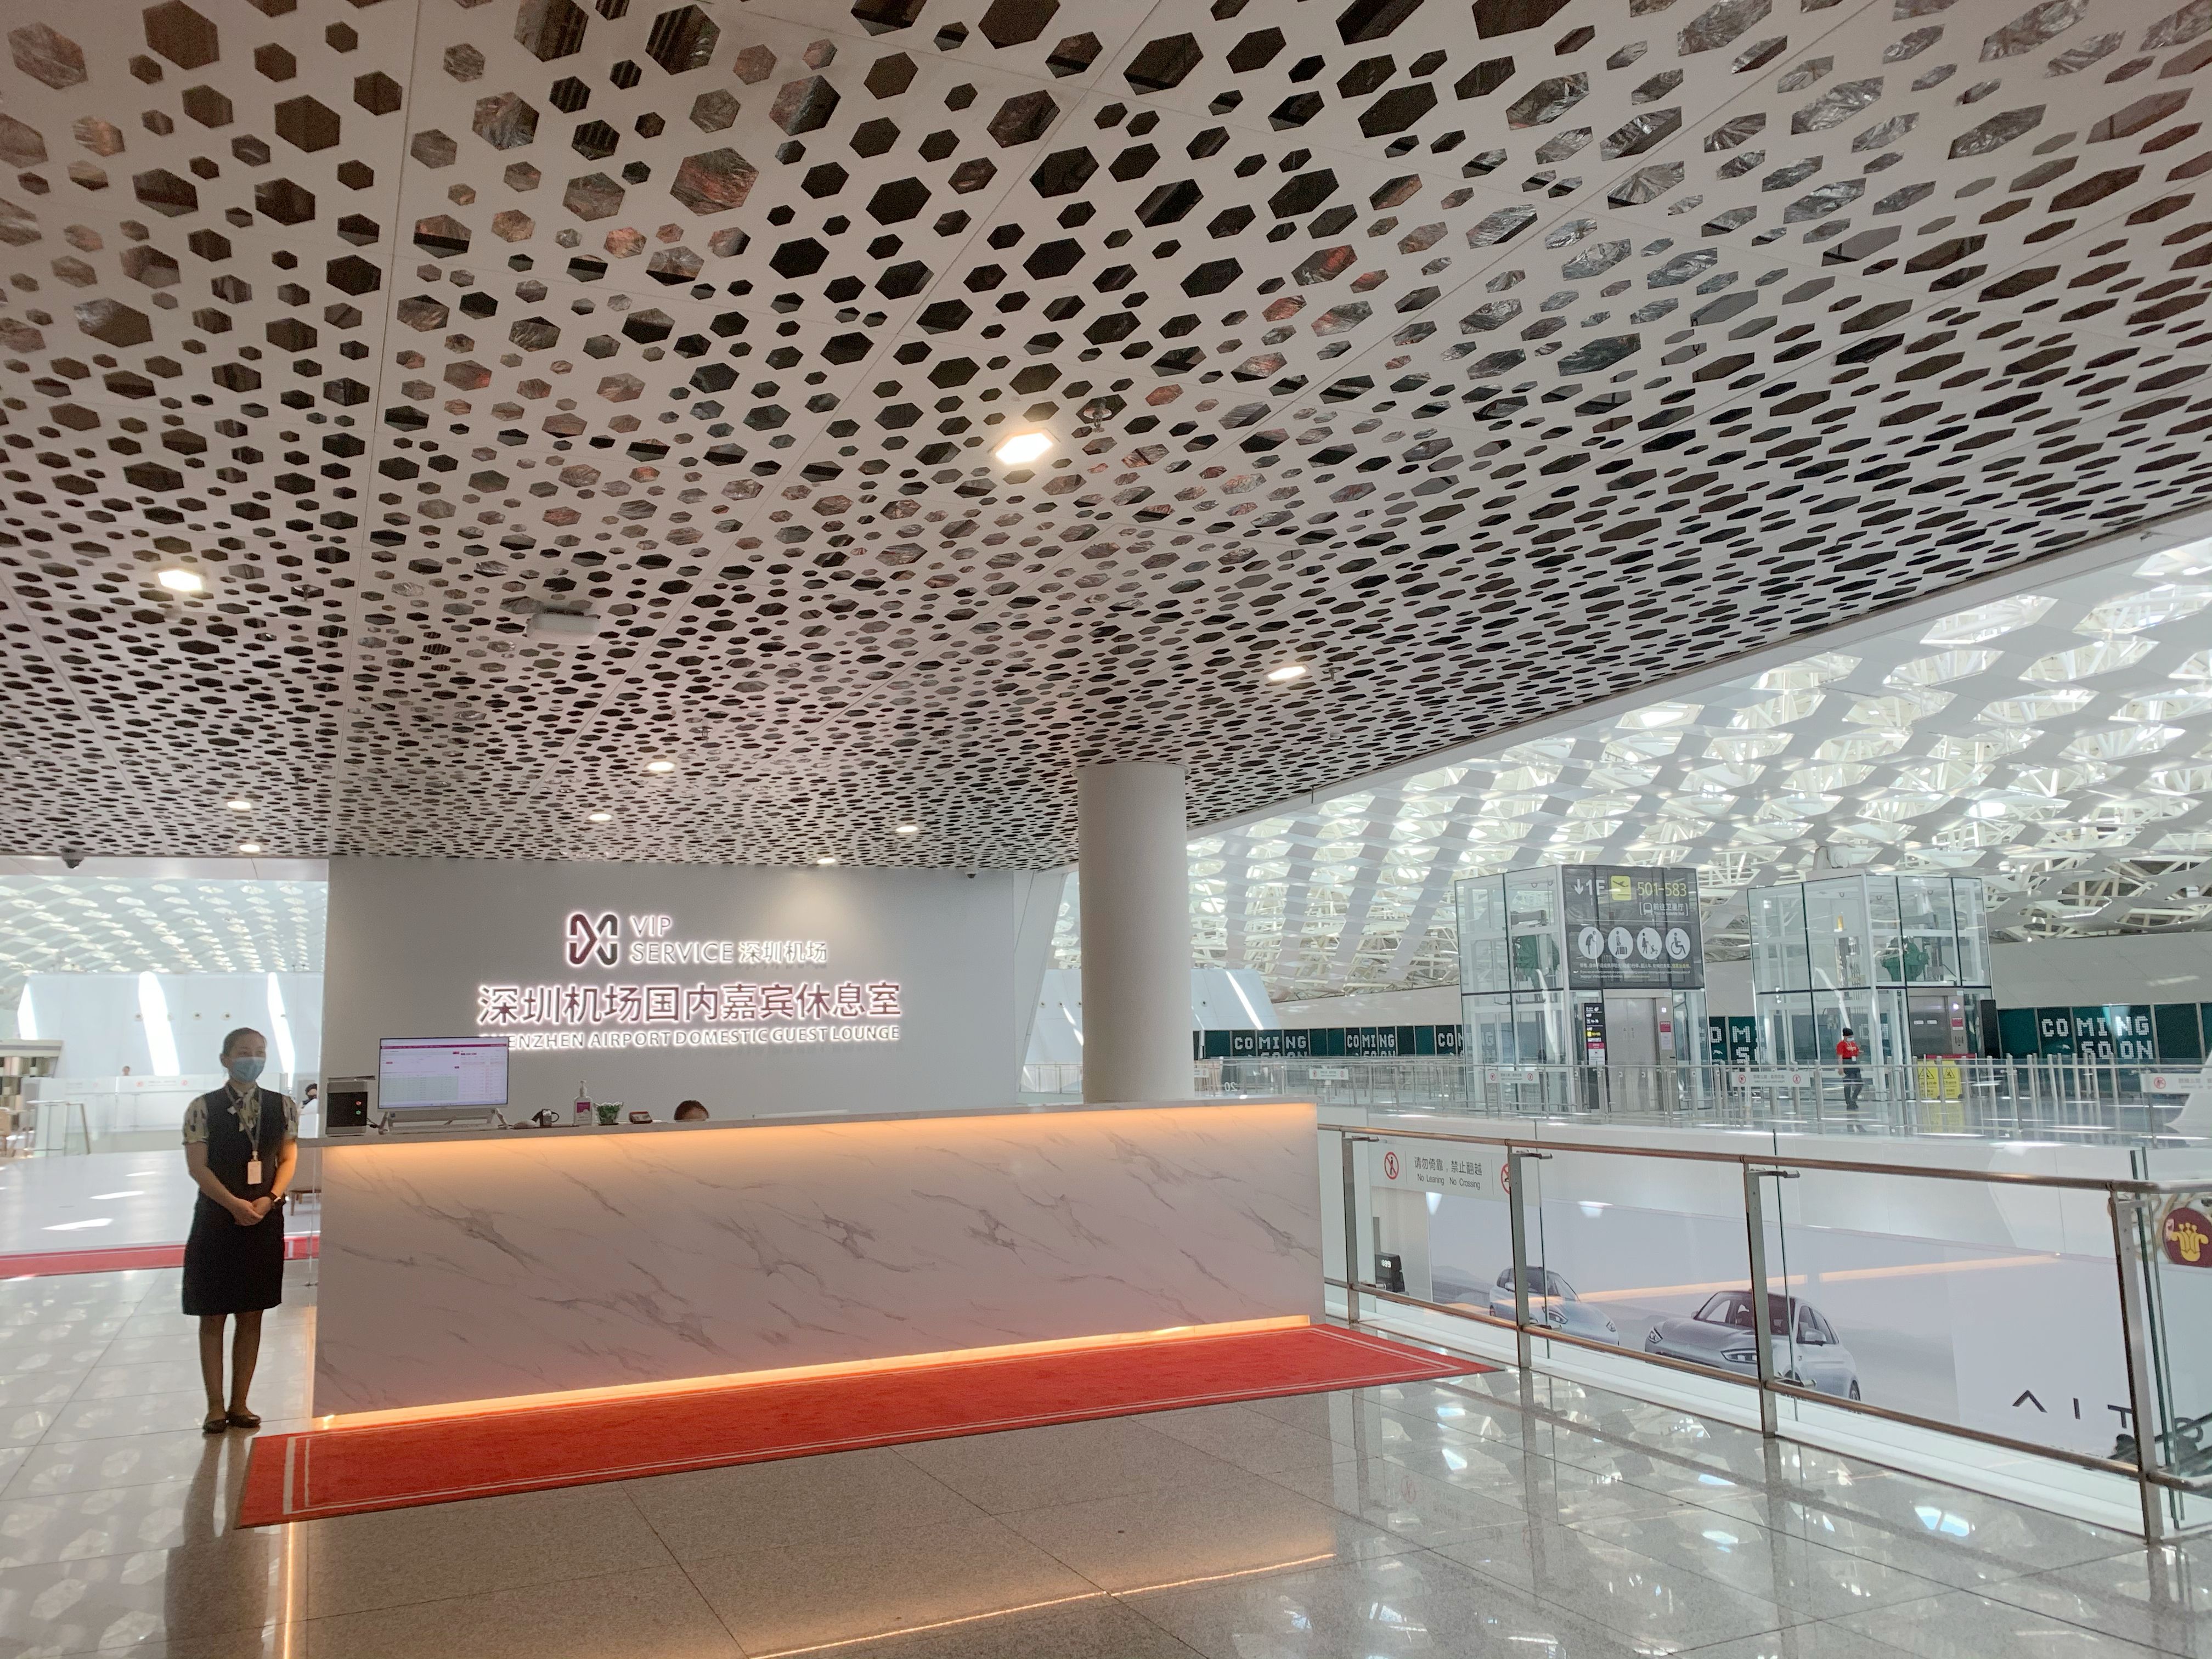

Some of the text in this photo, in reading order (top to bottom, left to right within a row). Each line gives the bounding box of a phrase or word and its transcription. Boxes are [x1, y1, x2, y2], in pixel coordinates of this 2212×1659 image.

[1585, 879, 1687, 897] 1F 501-583
[630, 916, 672, 936] VIP
[631, 941, 828, 963] SERVICE 深圳机场
[478, 981, 901, 1025] 深圳机场国内嘉宾休息室
[2041, 1016, 2150, 1037] COMING
[484, 1025, 901, 1050] ENZHEN AIRPORT DOMESTIC GUEST LOUNGE
[1234, 1036, 1306, 1050] COMING
[1347, 1034, 1395, 1048] COMING
[2081, 1040, 2153, 1059] SOON
[1417, 1173, 1480, 1190] No Leaning No Crossing
